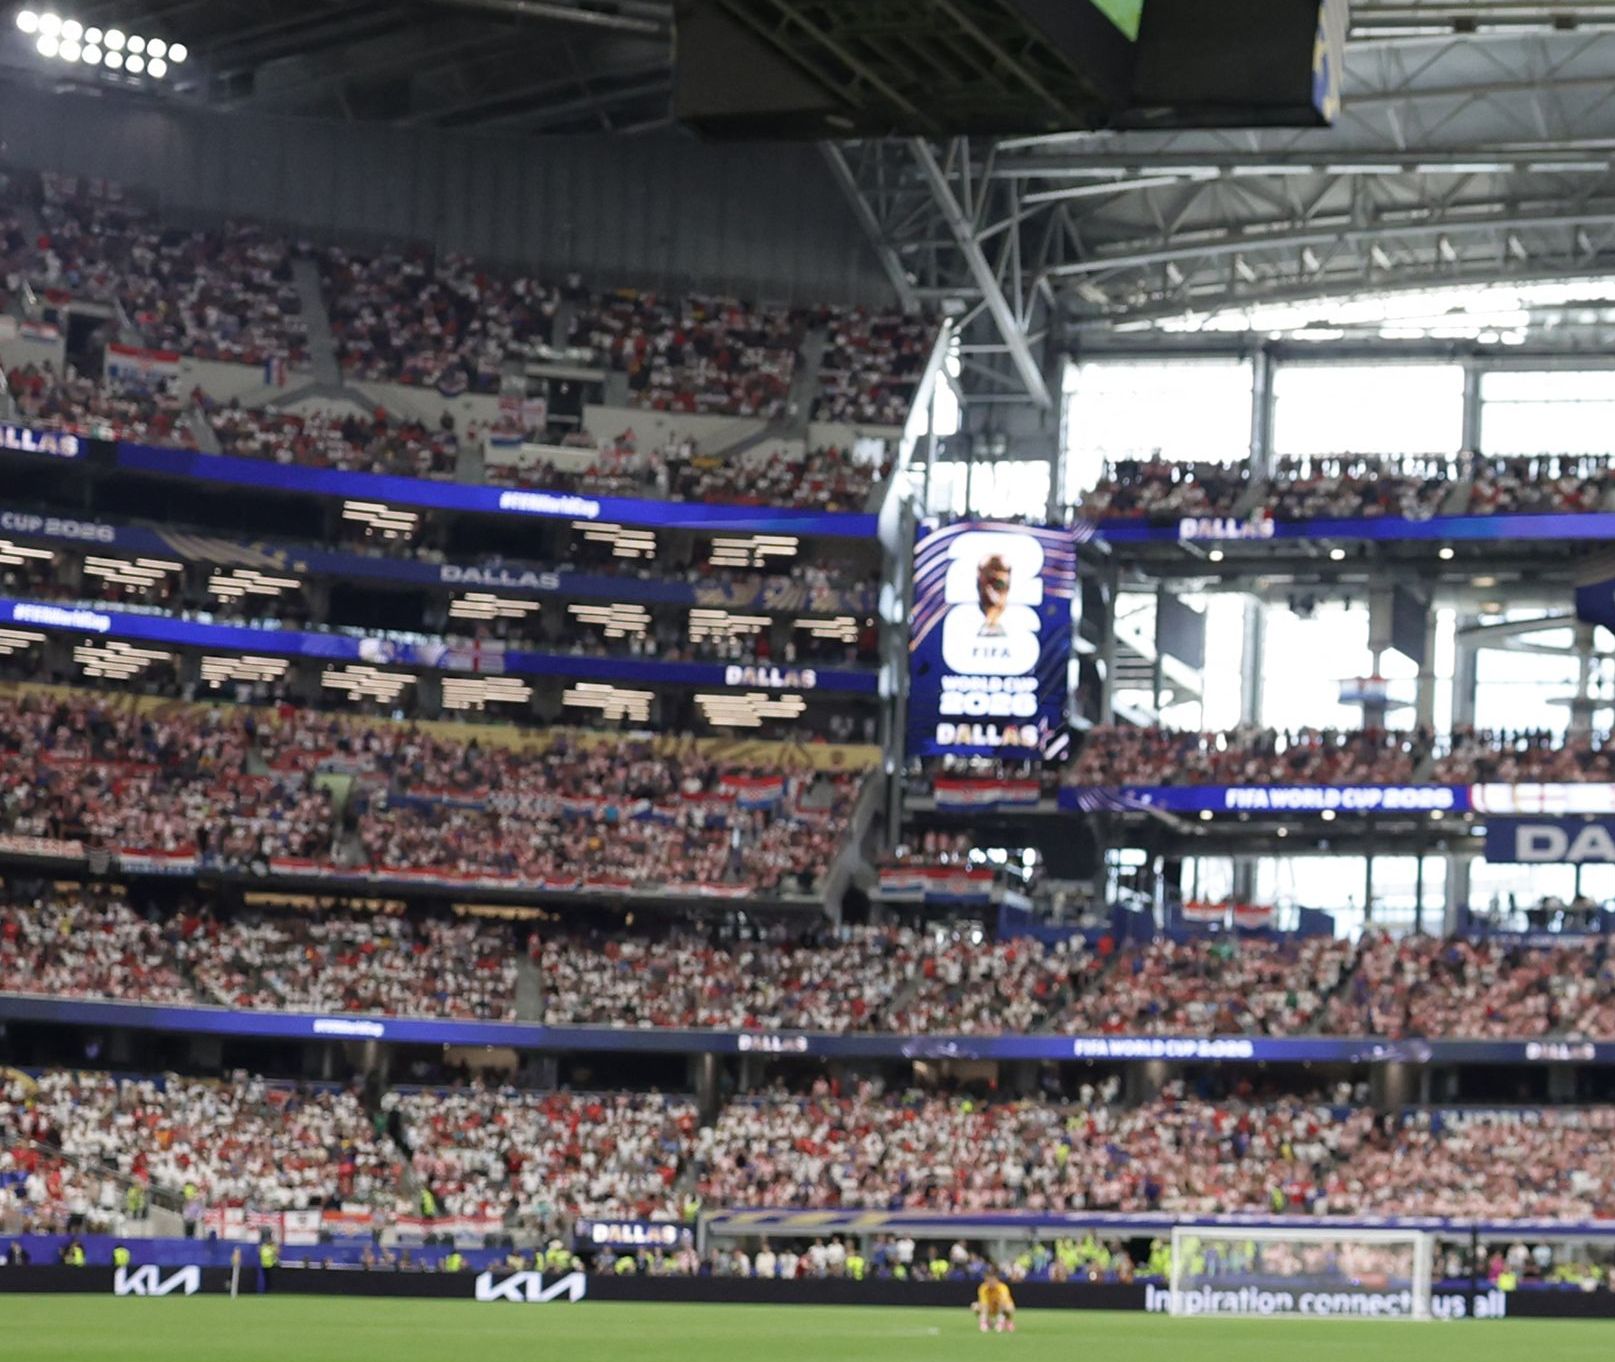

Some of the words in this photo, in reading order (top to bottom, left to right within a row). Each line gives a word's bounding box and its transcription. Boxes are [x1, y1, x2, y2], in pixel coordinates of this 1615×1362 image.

[0, 425, 80, 458] LLAS
[1, 511, 43, 537] CUP
[44, 517, 116, 543] 2026
[1179, 517, 1275, 540] DALLAS
[440, 564, 560, 590] DALLAS
[725, 665, 816, 688] DALLAS
[939, 691, 1038, 716] 2026
[936, 722, 1040, 746] DALLAS
[1225, 787, 1269, 809] FIFA
[1268, 787, 1342, 809] WORLD
[1342, 787, 1383, 809] CUP
[1382, 787, 1454, 809] 2026
[738, 1034, 808, 1052] DALLAS
[1073, 1039, 1109, 1057] FIFA
[1108, 1039, 1166, 1057] WORLD
[1166, 1039, 1198, 1057] CUP
[591, 1223, 679, 1245] DALLAS
[1145, 1284, 1293, 1318] Inpiration
[1300, 1289, 1413, 1316] connect
[1431, 1292, 1467, 1319] us
[1473, 1289, 1507, 1319] all
